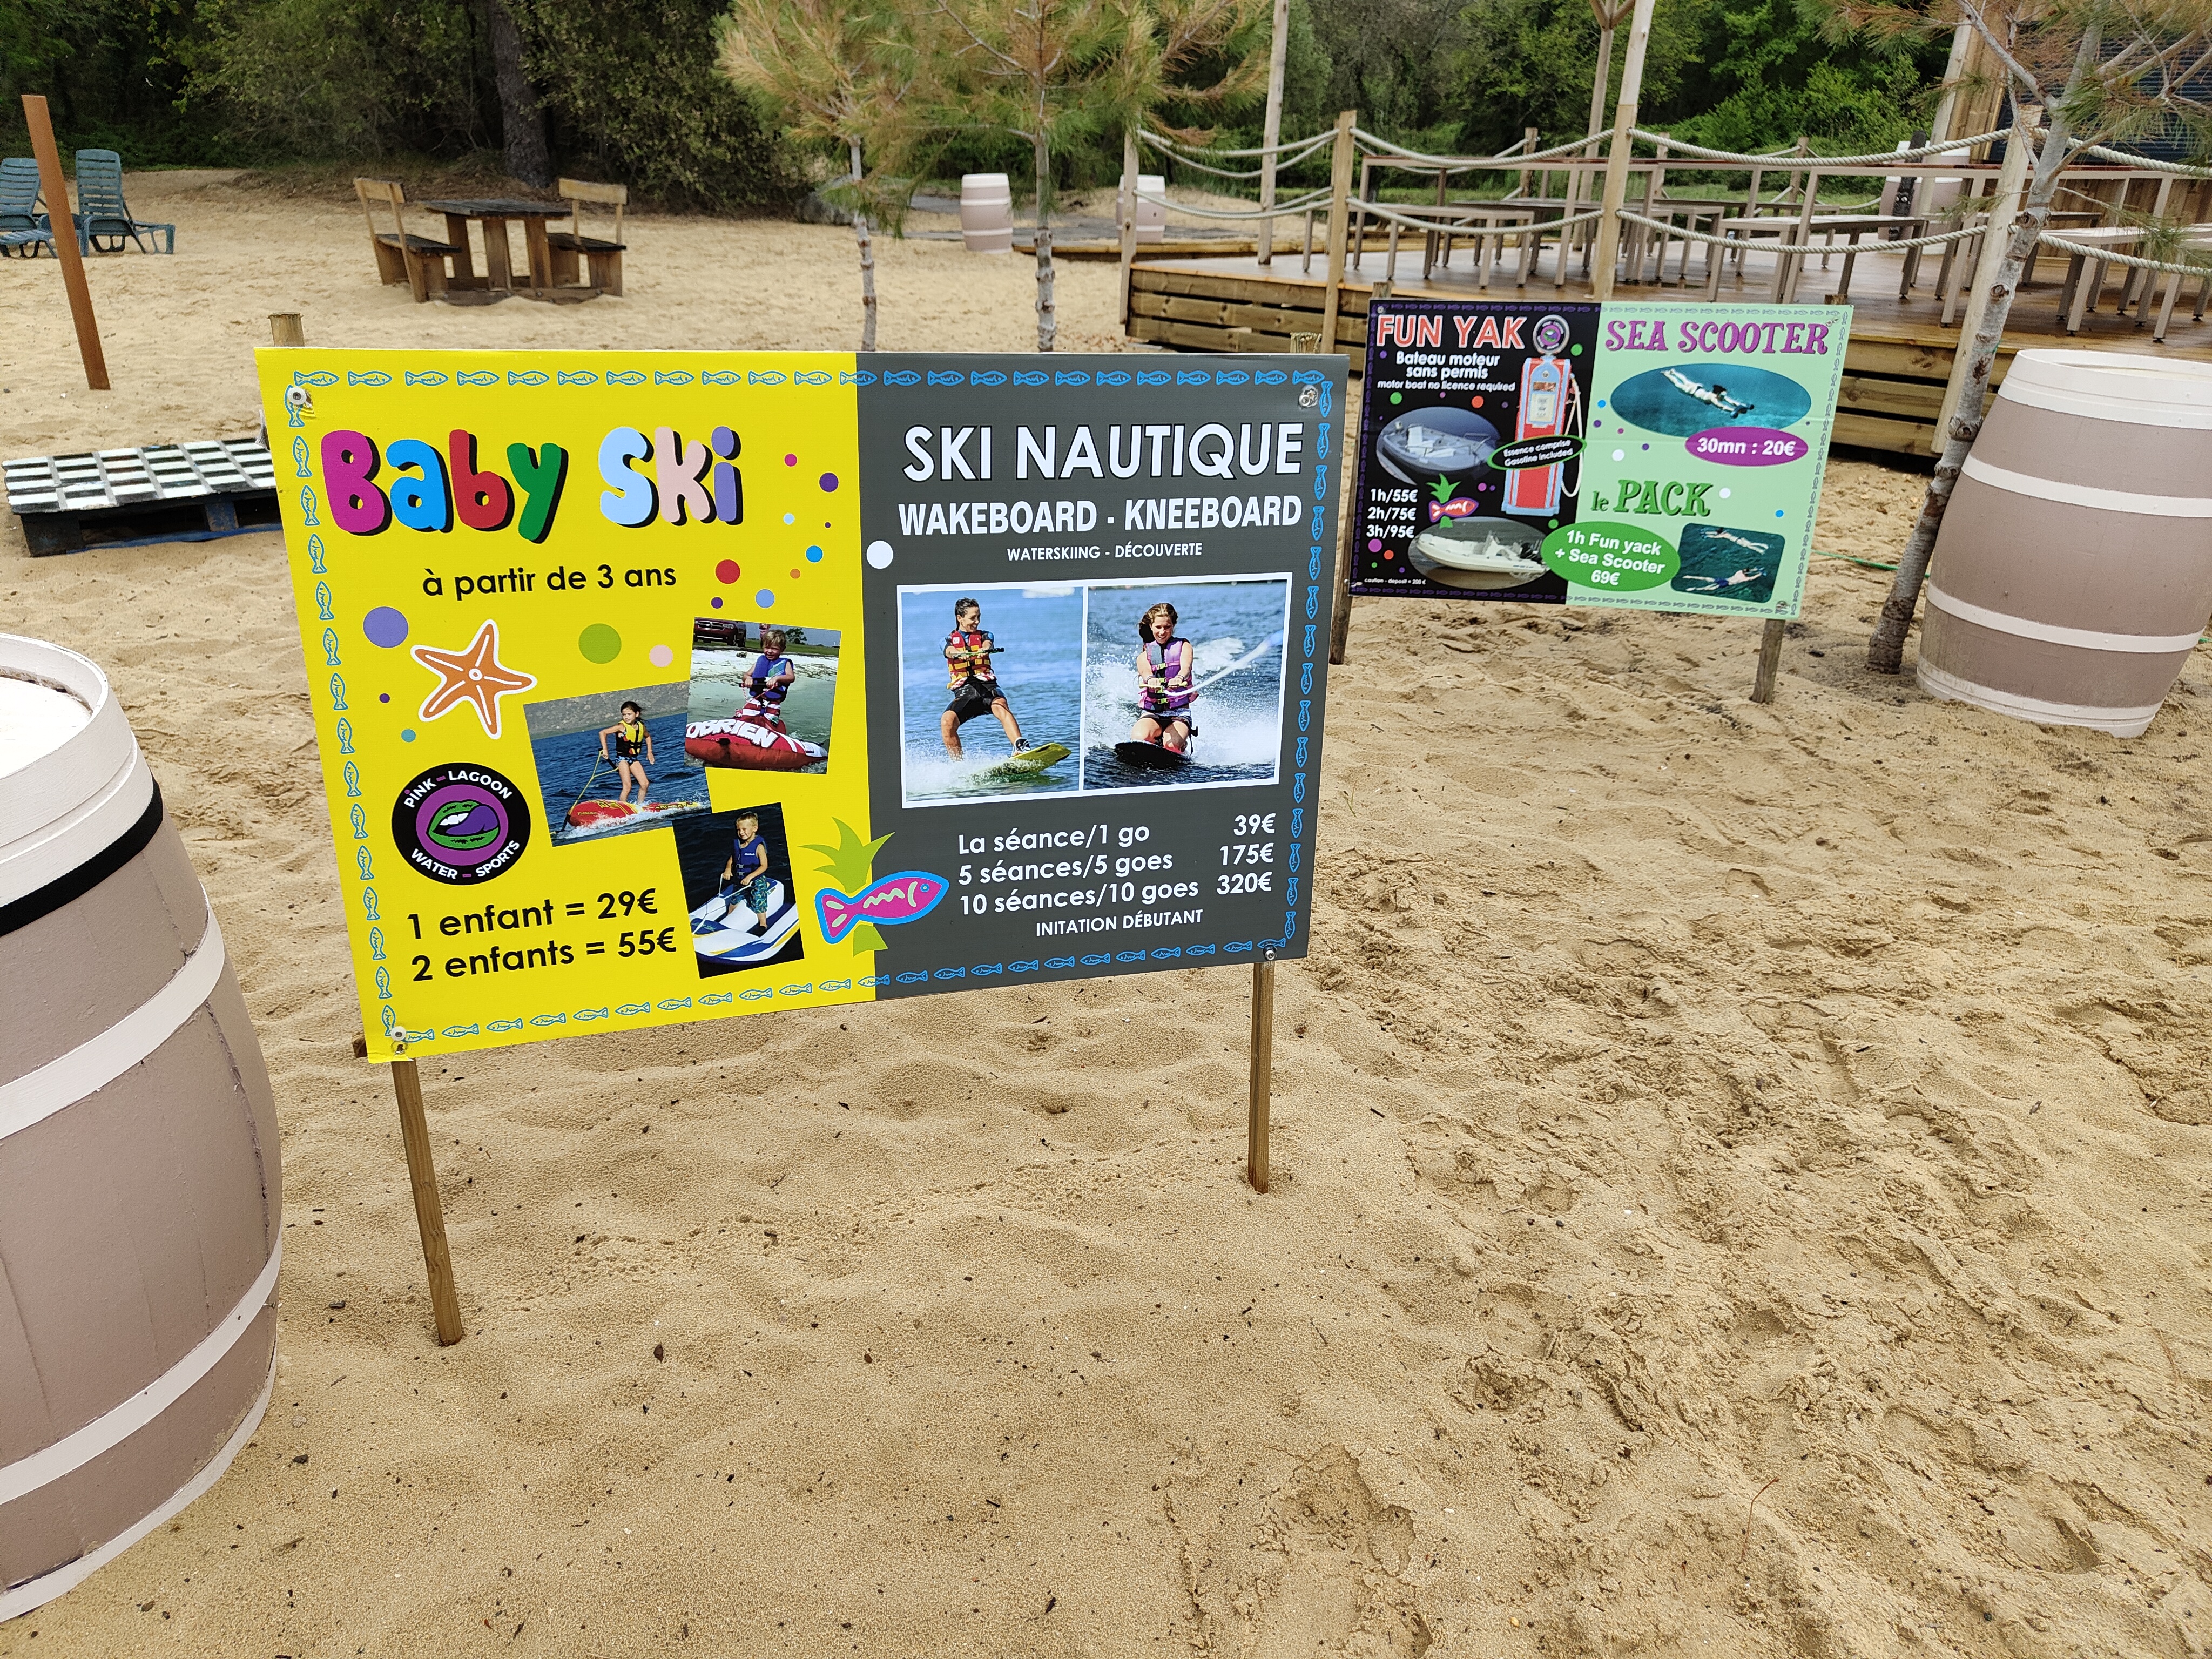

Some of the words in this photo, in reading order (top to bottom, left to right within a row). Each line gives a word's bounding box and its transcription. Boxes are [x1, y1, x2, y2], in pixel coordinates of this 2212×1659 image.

[1376, 314, 1443, 347] FUN
[1453, 315, 1527, 349] YAK
[1606, 320, 1668, 352] SEA
[1677, 320, 1828, 354] SCOOTER
[1396, 350, 1446, 365] Bateau
[1449, 352, 1501, 366] moteur
[1377, 380, 1404, 389] motor
[1405, 380, 1427, 389] boat
[1428, 381, 1440, 389] no
[1441, 380, 1475, 390] licence
[1476, 381, 1516, 393] required
[1406, 366, 1438, 378] sans
[1440, 365, 1488, 380] permis
[902, 424, 993, 482] SKI
[1016, 422, 1304, 480] NAUTIQUE
[1503, 446, 1535, 457] Essence
[1535, 440, 1572, 451] comprise
[1504, 455, 1538, 466] Gasoline
[1539, 448, 1573, 460] included
[1696, 437, 1746, 455] 30mn
[1752, 441, 1757, 455] :
[1762, 439, 1796, 456] 20€
[321, 429, 569, 544] Baby
[598, 426, 744, 529] Ski
[1371, 488, 1418, 503] 1h/55€
[1590, 490, 1609, 512] le
[1613, 480, 1713, 516] PACK
[899, 499, 1097, 535] WAKEBOARD
[1125, 495, 1302, 531] KNEEBOARD
[1367, 506, 1417, 521] 2h/75€
[1366, 524, 1415, 539] 3h/95€
[1567, 530, 1586, 545] 1h
[1589, 532, 1620, 550] Fun
[1622, 541, 1662, 556] yack
[1007, 546, 1101, 561] WATERSKIING
[1115, 541, 1202, 558] DÉCOUVERTE
[1555, 548, 1566, 558] +
[1568, 548, 1599, 565] Sea
[1602, 552, 1666, 574] Scooter
[423, 568, 443, 596] à
[455, 567, 536, 601] partir
[547, 565, 587, 591] de
[597, 564, 614, 589] 3
[625, 568, 677, 588] ans
[1591, 569, 1621, 586] 69€
[448, 770, 512, 799] LAGOON
[959, 834, 986, 854] La
[994, 824, 1109, 852] séance/1
[1118, 824, 1150, 848] go
[1233, 813, 1276, 837] 39€
[411, 848, 458, 879] WATER
[475, 840, 520, 877] SPORTS
[958, 865, 972, 885] 5
[980, 854, 1108, 882] séances/5
[1115, 852, 1172, 878] goes
[1219, 842, 1274, 866] 175€
[960, 894, 987, 915] 10
[994, 881, 1135, 913] séances/10
[1142, 879, 1199, 905] goes
[1216, 871, 1272, 895] 320€
[407, 913, 422, 939] 1
[439, 899, 554, 936] enfant
[597, 888, 658, 920] 29€
[1036, 916, 1117, 936] INITATION
[1123, 909, 1203, 929] DÉBUTANT
[411, 955, 433, 982] 2
[444, 940, 574, 978] enfants
[617, 927, 677, 958] 55€
